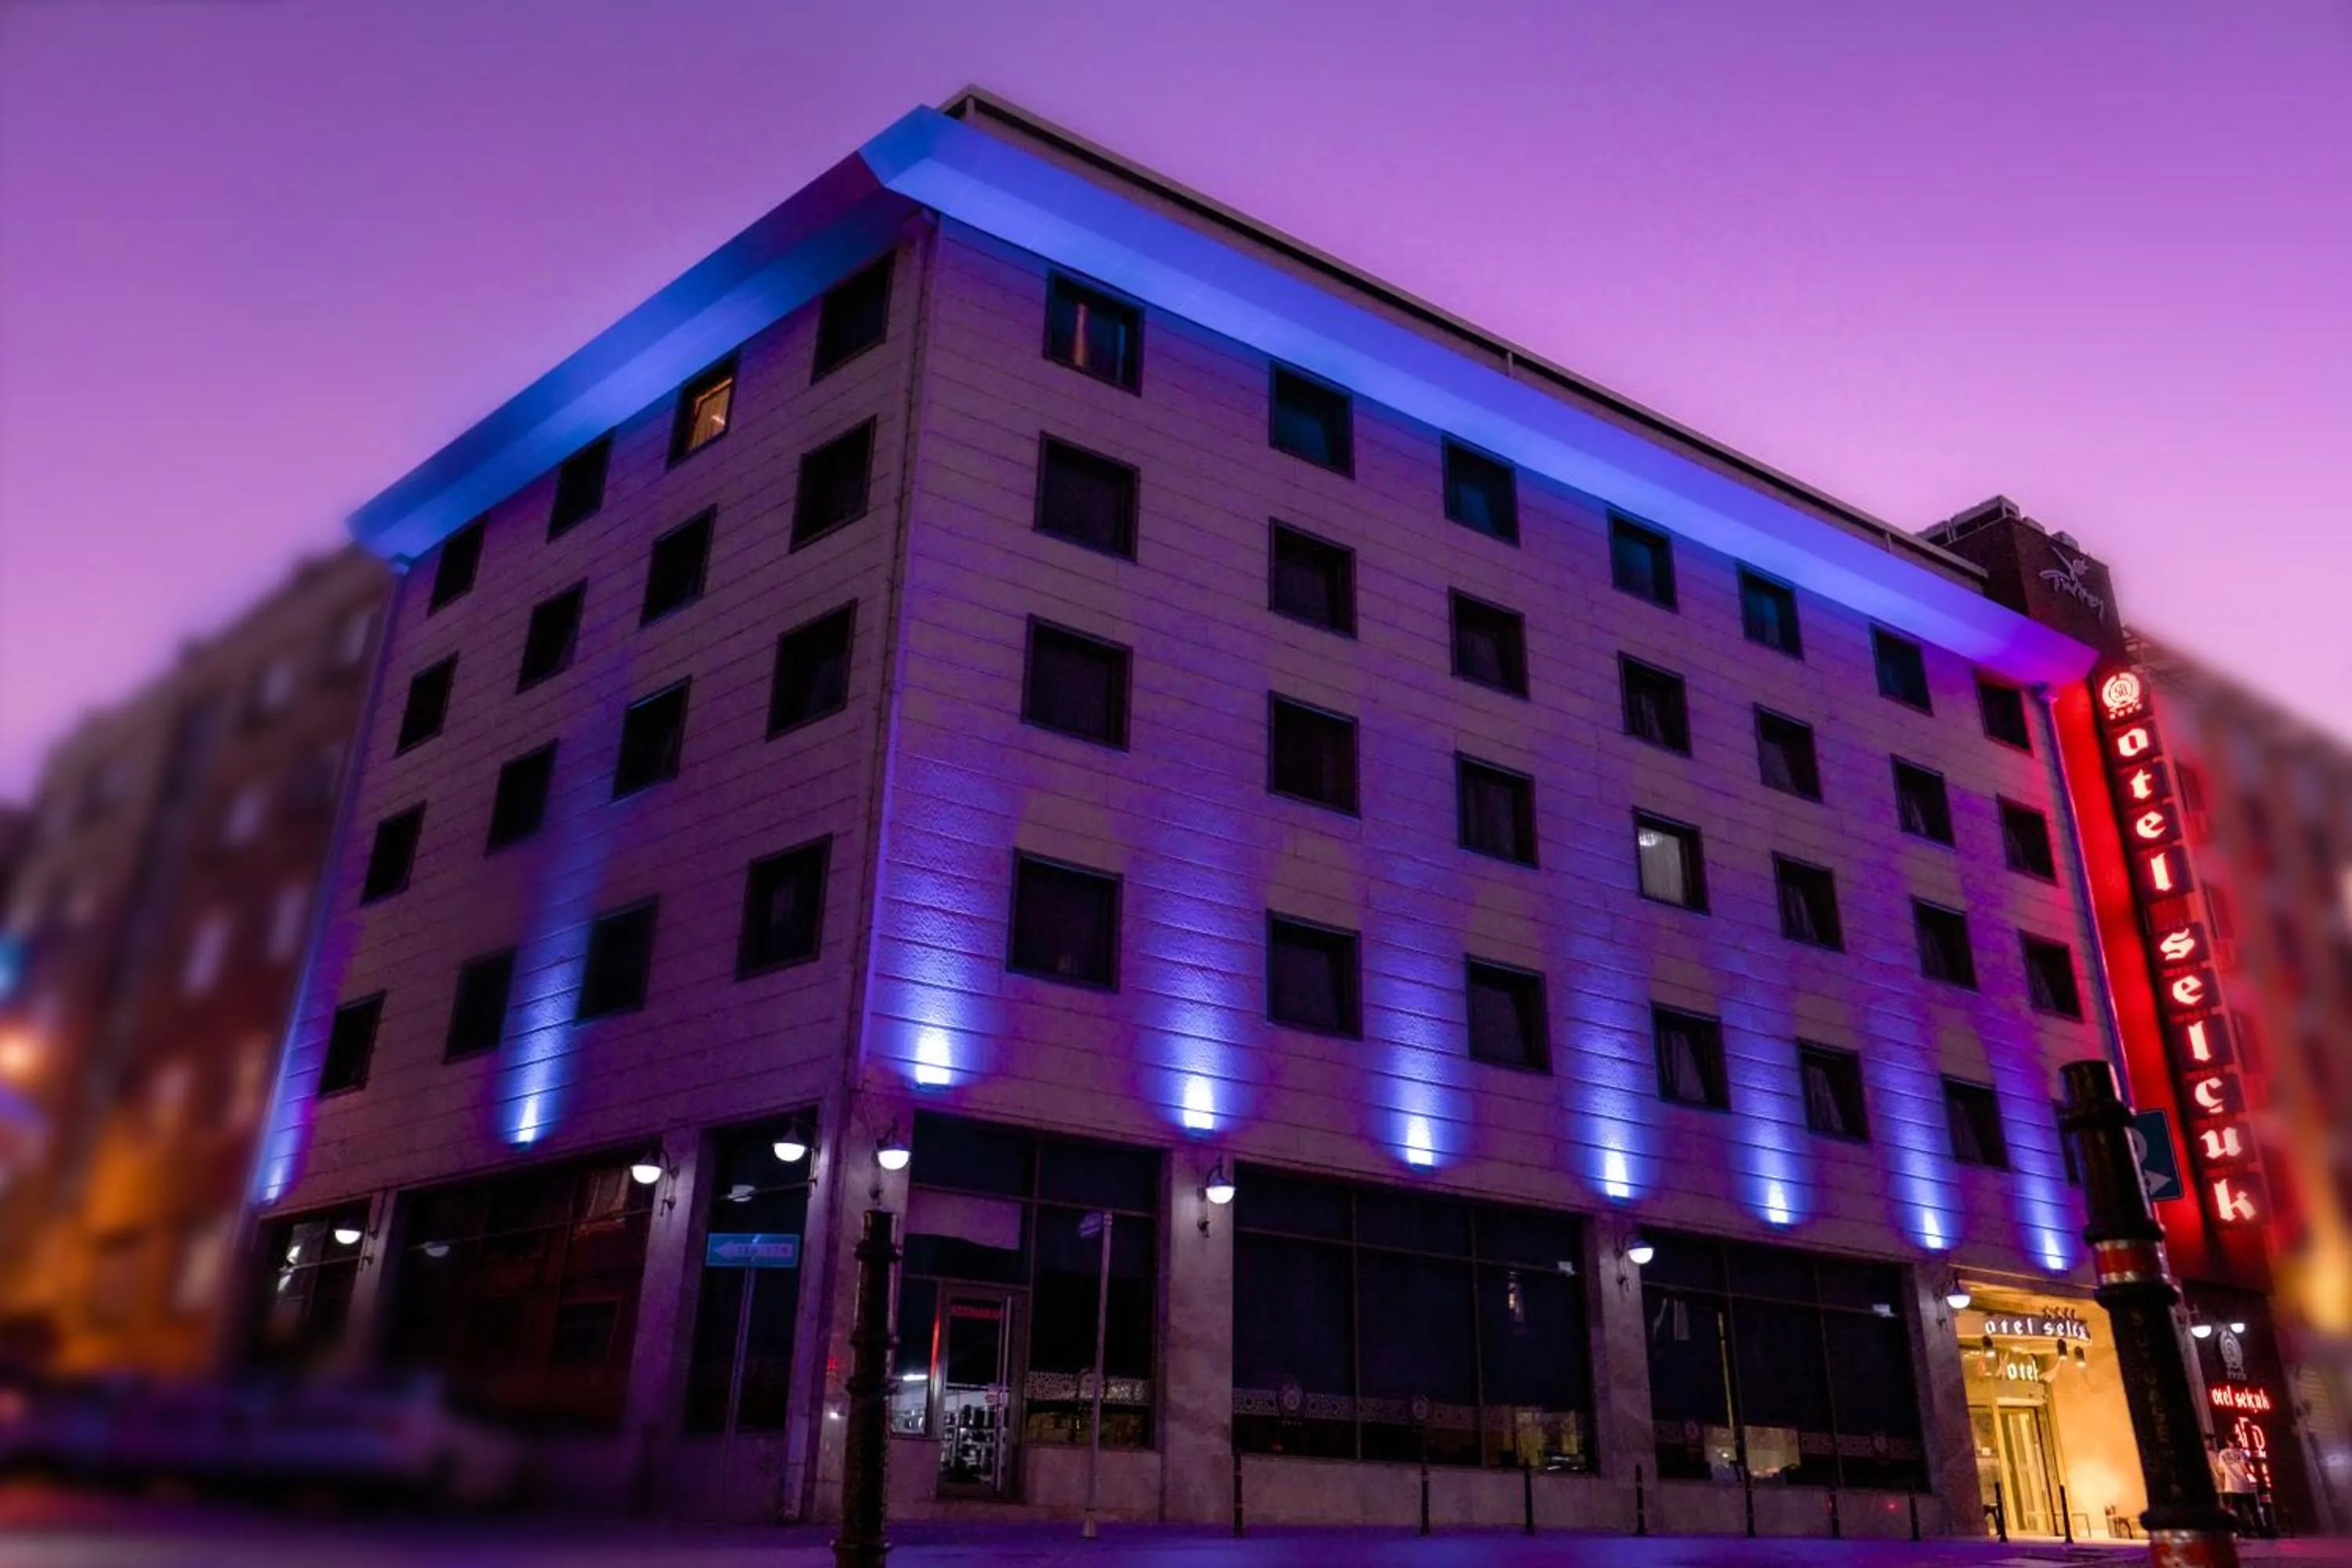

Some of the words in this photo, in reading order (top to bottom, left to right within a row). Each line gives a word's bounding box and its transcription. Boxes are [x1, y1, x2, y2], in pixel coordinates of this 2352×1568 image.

[2118, 727, 2172, 891] otel
[2160, 927, 2257, 1222] selçuk
[1984, 1317, 2033, 1334] otel
